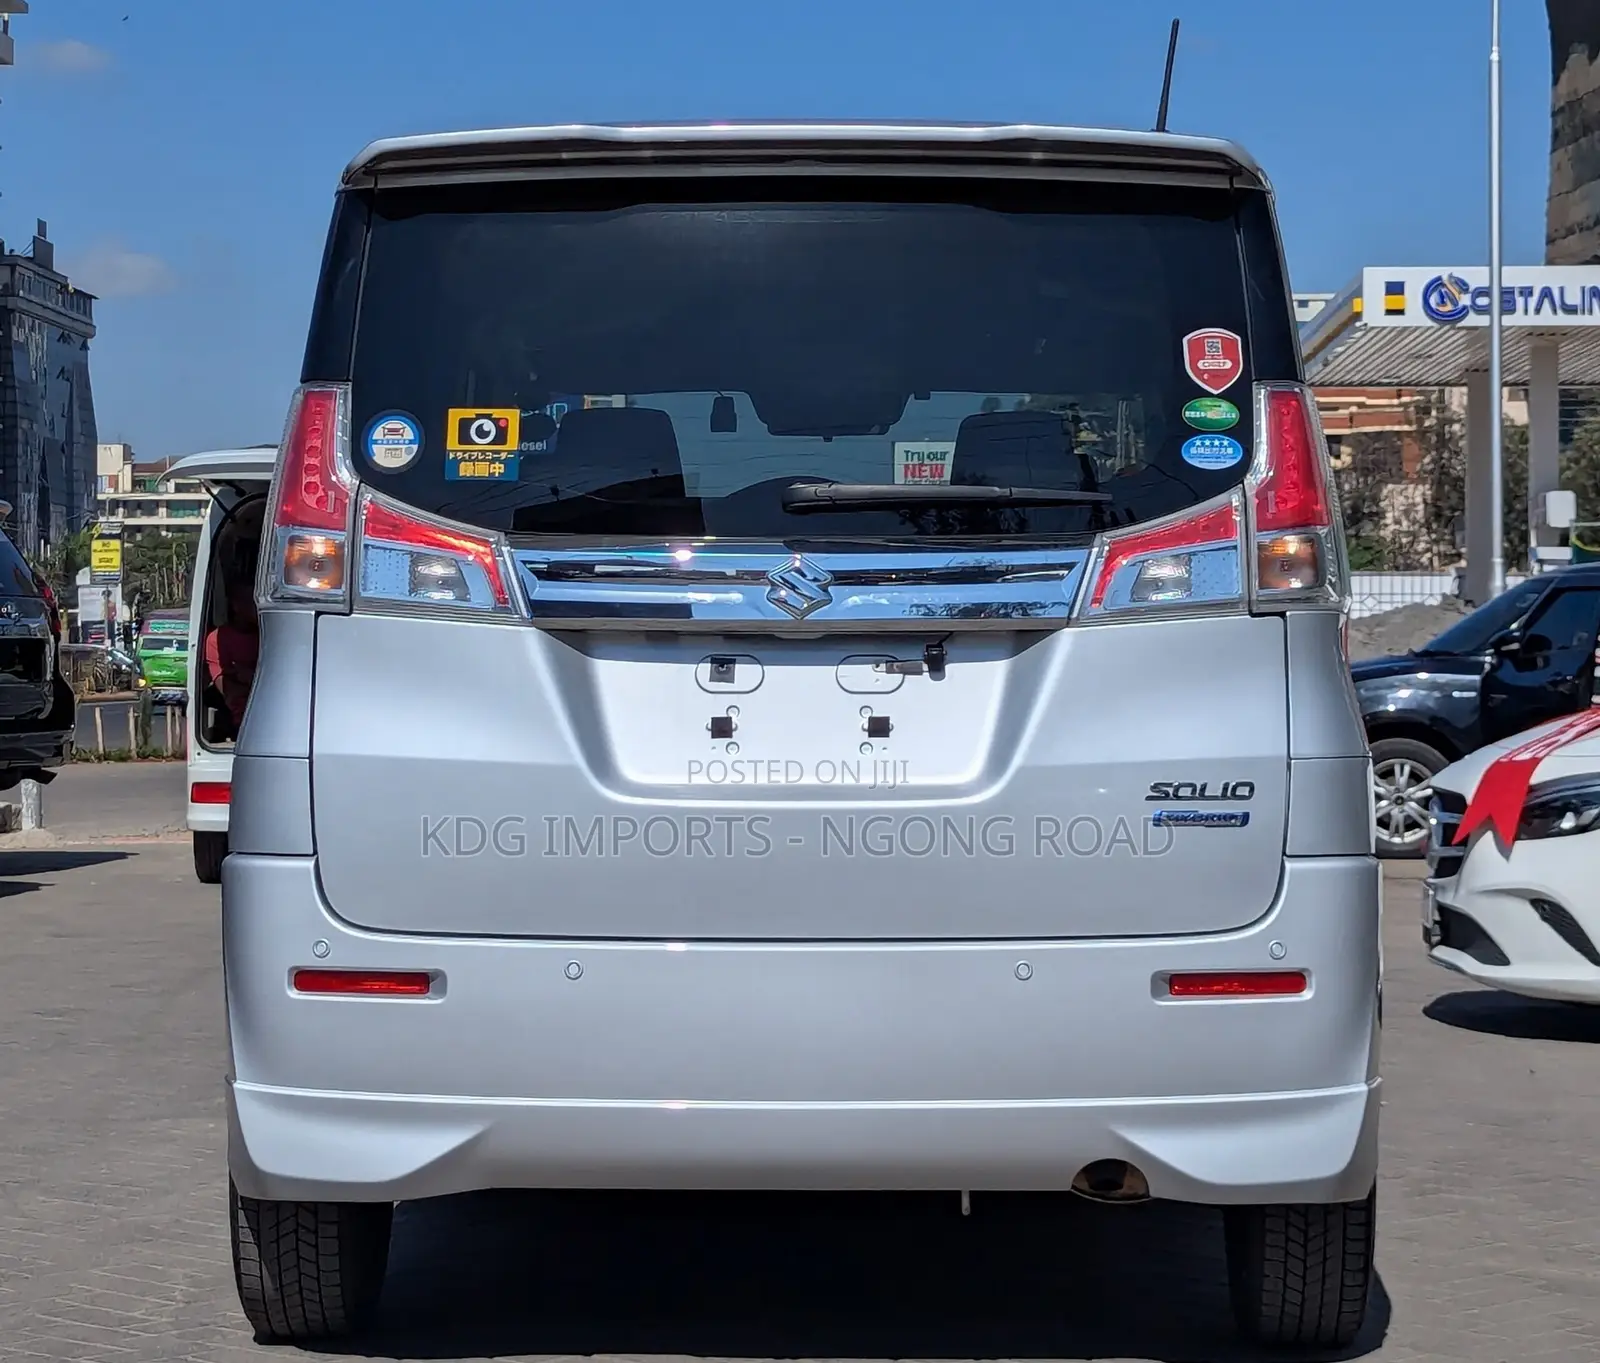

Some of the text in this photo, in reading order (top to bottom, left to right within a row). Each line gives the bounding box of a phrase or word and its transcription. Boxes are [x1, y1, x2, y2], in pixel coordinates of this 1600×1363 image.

[903, 450, 949, 463] Try our
[903, 464, 946, 478] NEW
[1144, 781, 1256, 801] SOLIO
